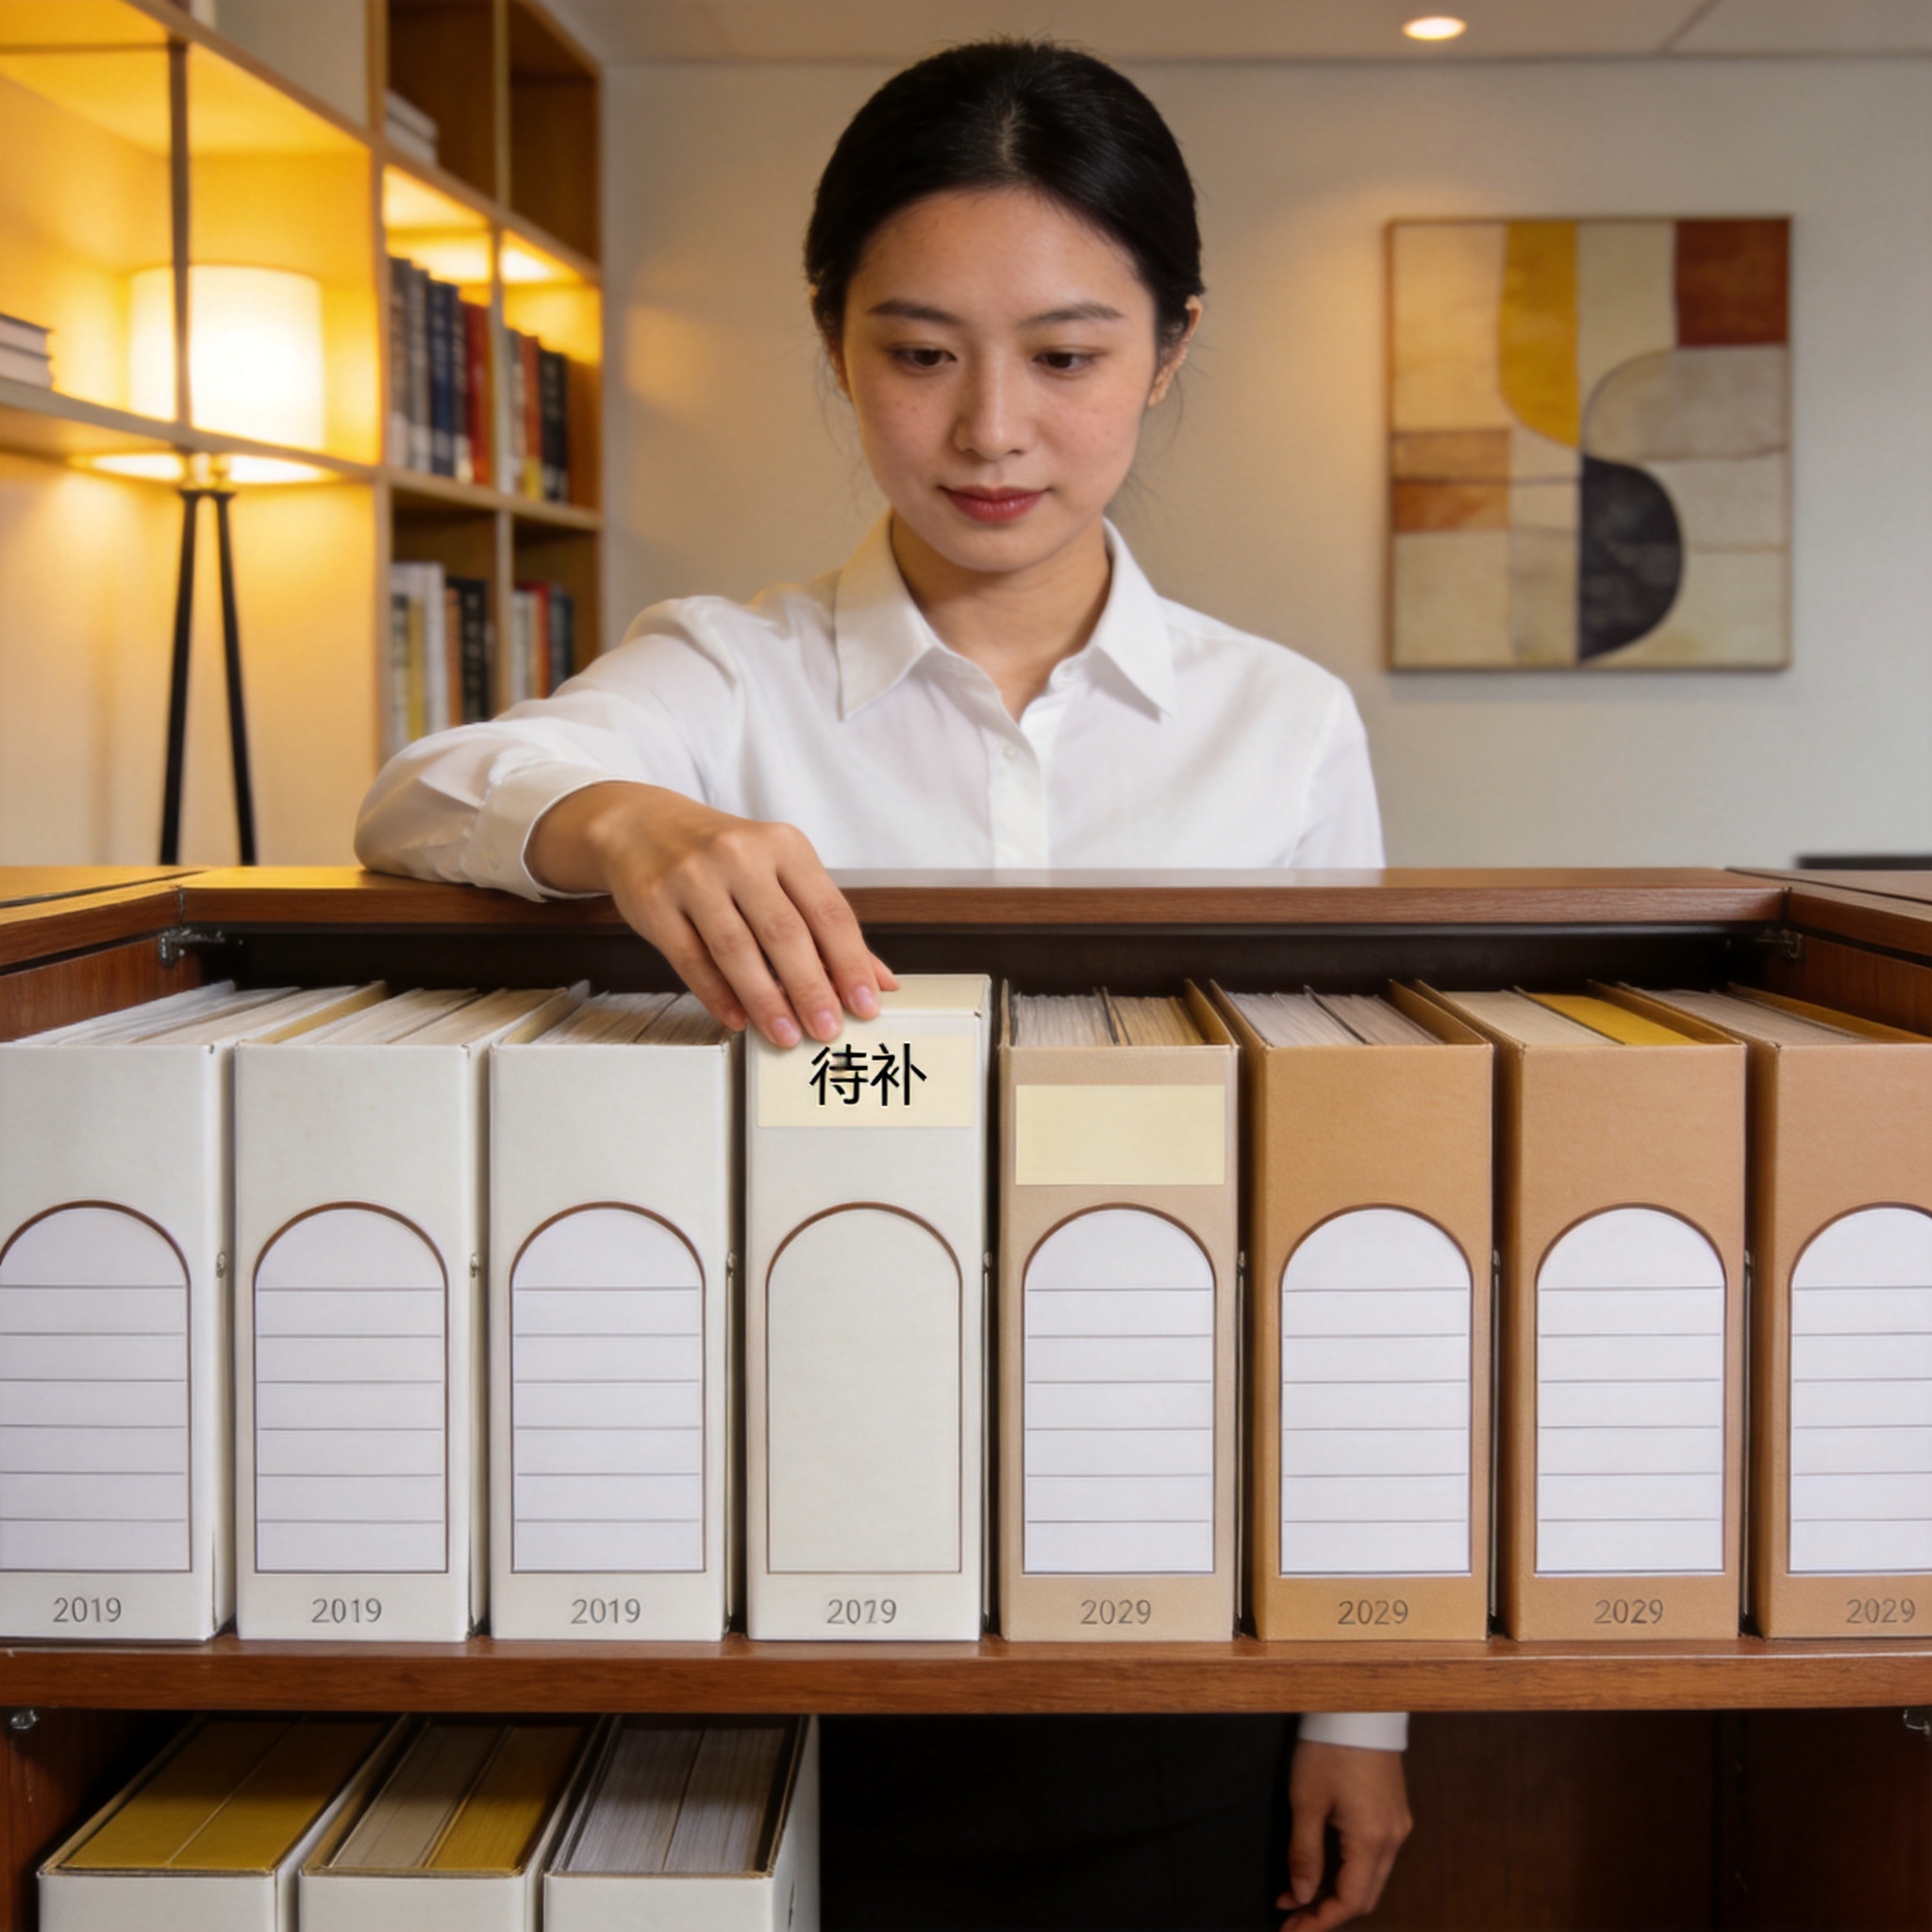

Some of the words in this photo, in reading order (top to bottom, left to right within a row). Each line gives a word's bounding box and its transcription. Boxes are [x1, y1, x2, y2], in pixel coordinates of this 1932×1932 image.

[809, 1042, 927, 1107] 待补
[53, 1596, 122, 1623] 2019
[311, 1598, 382, 1624] 2019
[571, 1598, 641, 1624] 2019
[1081, 1599, 1151, 1624] 2029
[1338, 1599, 1407, 1624] 2029
[1594, 1599, 1663, 1624] 2029
[1846, 1599, 1916, 1624] 2029
